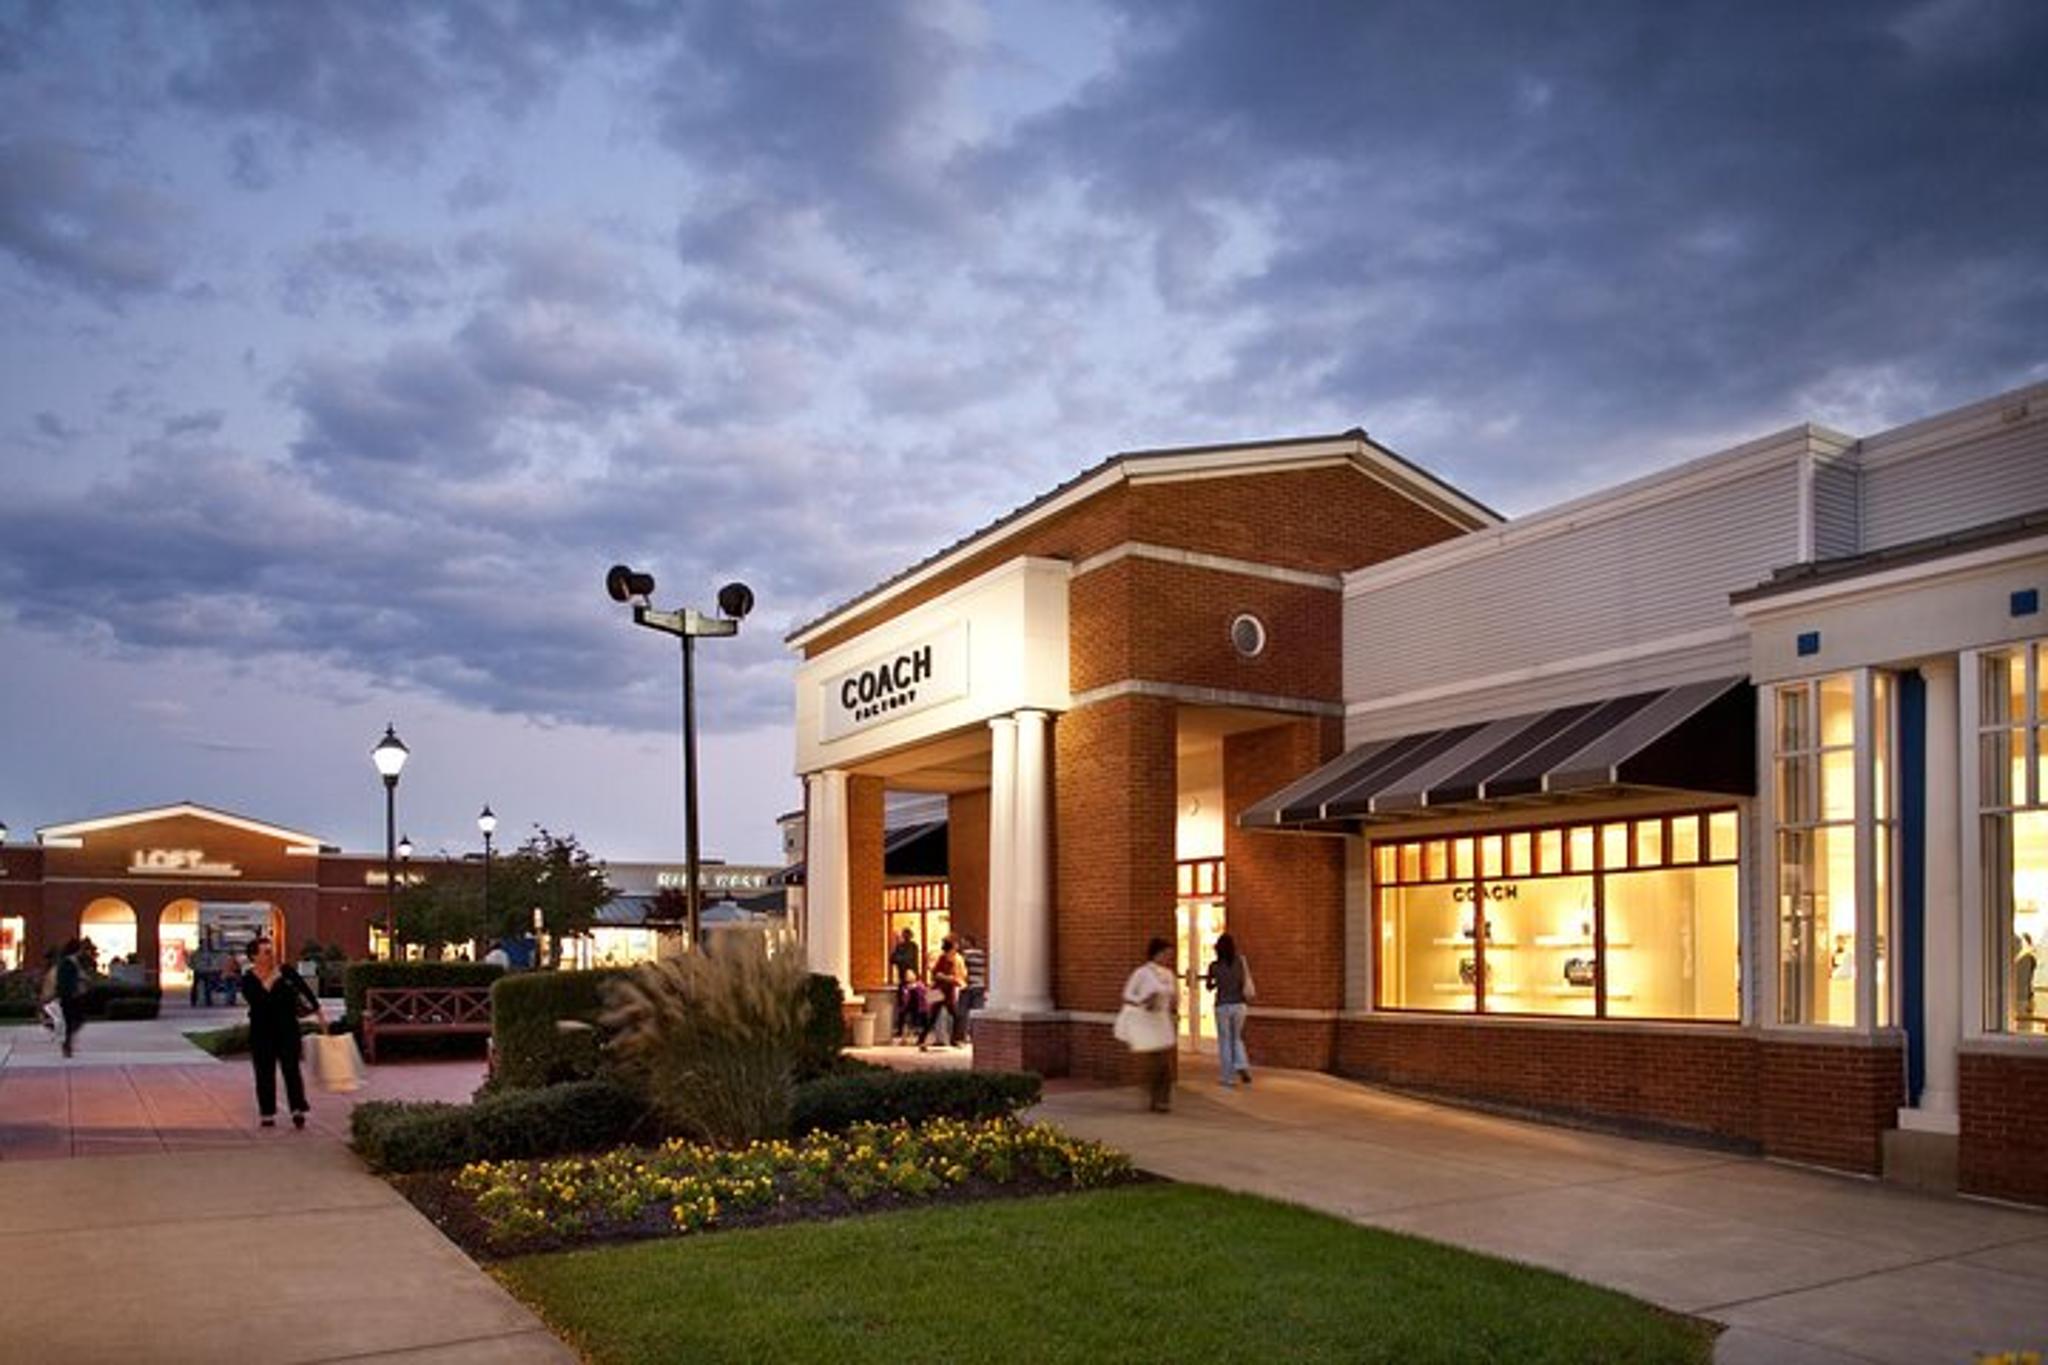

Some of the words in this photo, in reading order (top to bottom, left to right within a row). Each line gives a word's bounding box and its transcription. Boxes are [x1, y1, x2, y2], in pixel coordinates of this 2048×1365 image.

[841, 645, 931, 709] COACH
[855, 690, 916, 721] FACTORY
[135, 849, 204, 869] LOFT
